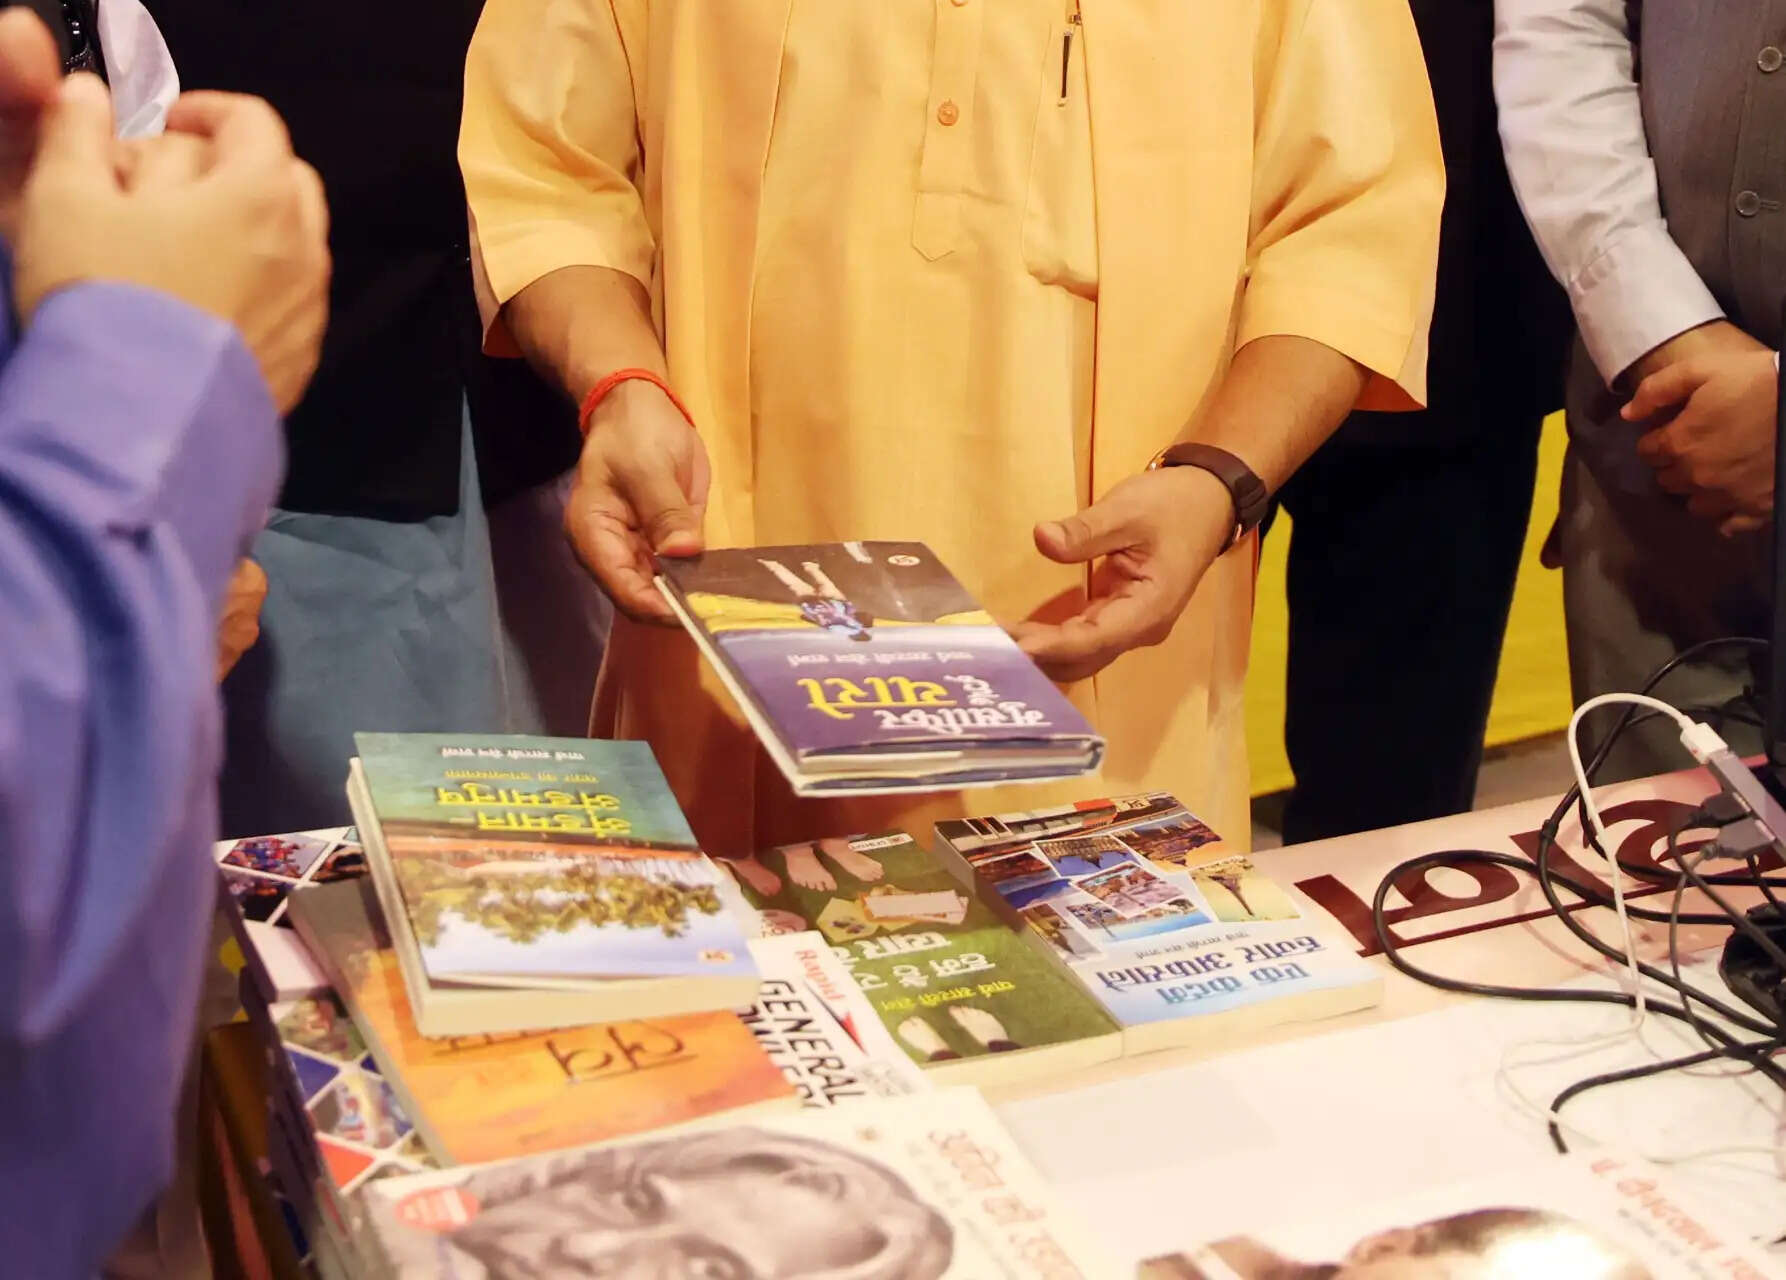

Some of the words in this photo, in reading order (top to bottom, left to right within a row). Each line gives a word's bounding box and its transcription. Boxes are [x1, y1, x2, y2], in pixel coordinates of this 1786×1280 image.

[795, 675, 956, 718] यारो
[872, 700, 1050, 732] मुसाफिर
[852, 930, 951, 959] प्यार
[1233, 934, 1326, 963] हजार
[927, 950, 995, 977] हम
[1094, 950, 1231, 992] अफसाने
[1248, 960, 1309, 984] एक
[1154, 973, 1247, 1004] कदम
[760, 980, 866, 1105] GENERAL
